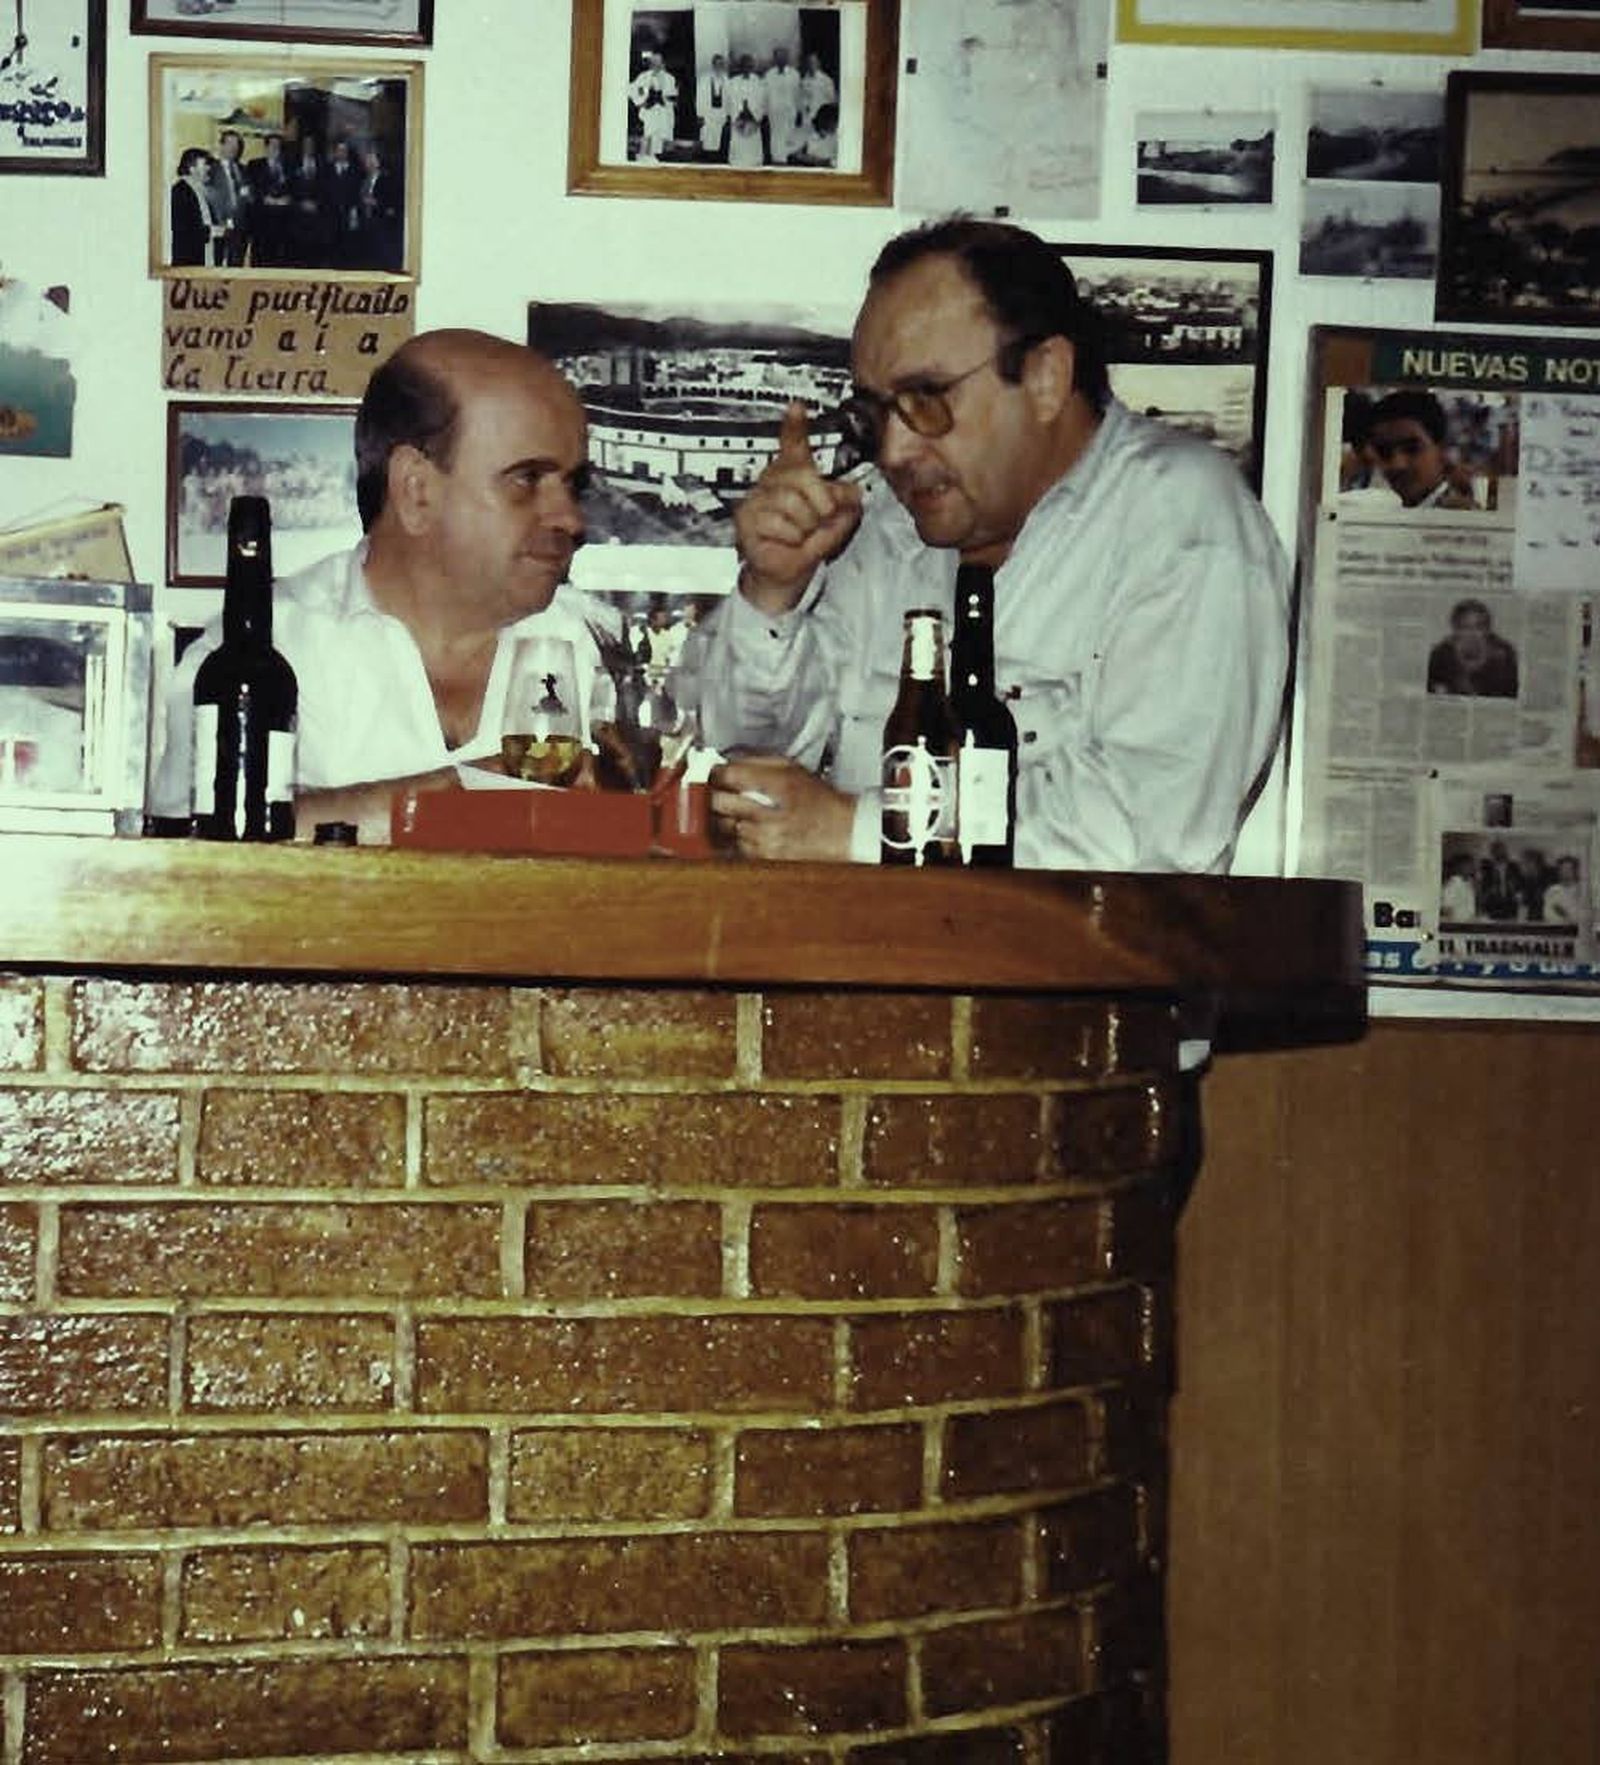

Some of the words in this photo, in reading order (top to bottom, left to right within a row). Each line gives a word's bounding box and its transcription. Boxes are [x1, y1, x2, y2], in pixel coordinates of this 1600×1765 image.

[246, 284, 410, 324] purificado
[277, 329, 297, 352] a
[358, 332, 379, 354] a
[1402, 349, 1528, 382] NUEVAS
